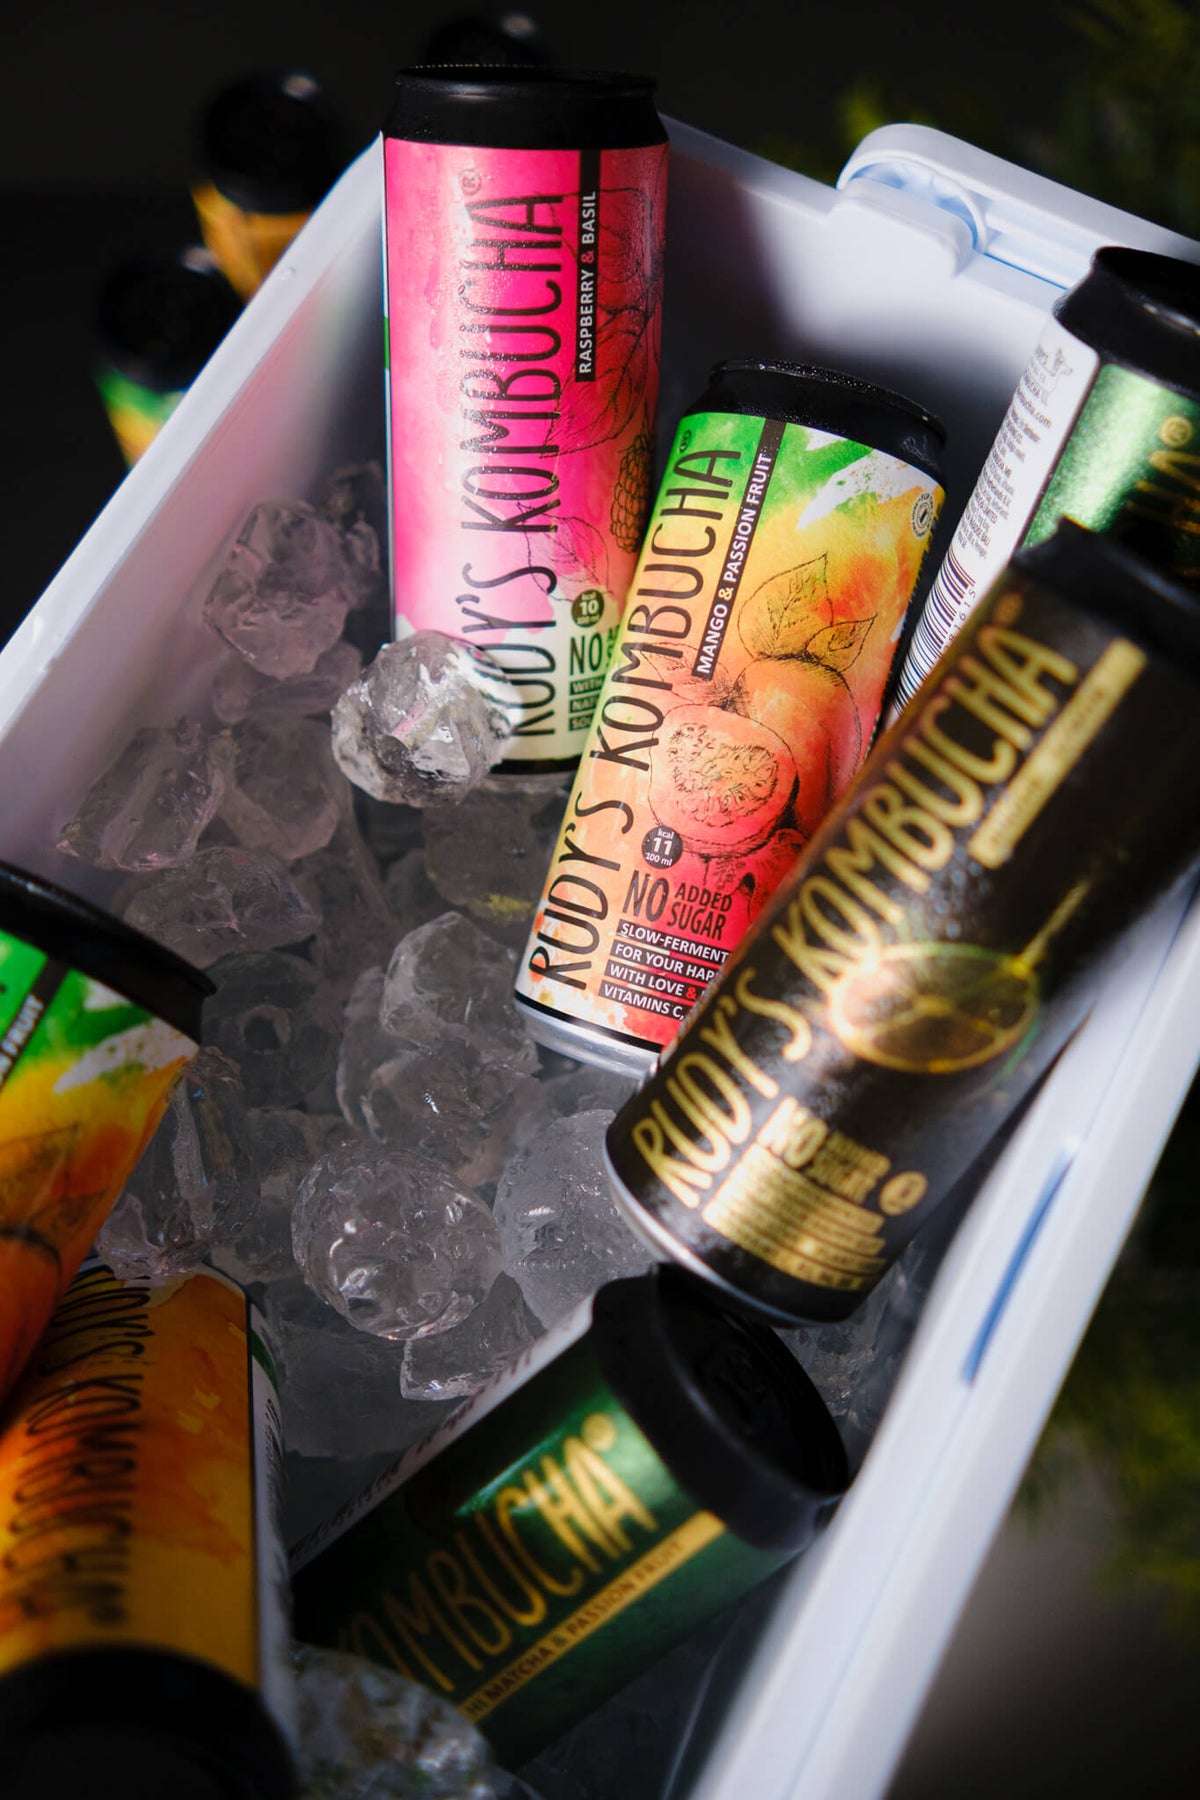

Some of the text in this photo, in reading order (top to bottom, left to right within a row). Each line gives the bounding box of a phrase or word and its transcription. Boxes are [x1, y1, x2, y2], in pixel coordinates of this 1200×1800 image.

[579, 190, 597, 374] RASPBERRY & BASIL
[459, 194, 565, 532] KOMBUCHA
[696, 453, 773, 674] MANGO & PASSION FRUIT
[579, 600, 599, 616] 10
[570, 632, 603, 676] NO
[528, 448, 742, 992] RUDY'S KOMBUCHA
[653, 836, 673, 856] 11
[657, 828, 675, 840] kcal
[645, 851, 673, 866] 100 ml
[622, 869, 670, 922] NO
[674, 882, 733, 913] ADDED
[631, 964, 815, 1211] RUDY'S
[773, 626, 1080, 992] KOMBUCHA
[667, 901, 727, 941] SUGAR
[614, 943, 643, 961] FOR
[645, 951, 684, 974] YOUR
[603, 983, 671, 1015] VITAMINS
[609, 963, 649, 985] WITH
[647, 975, 685, 996] LOVE
[685, 986, 697, 999] &
[484, 1646, 555, 1700] MATCHA
[566, 1581, 637, 1637] PASSION
